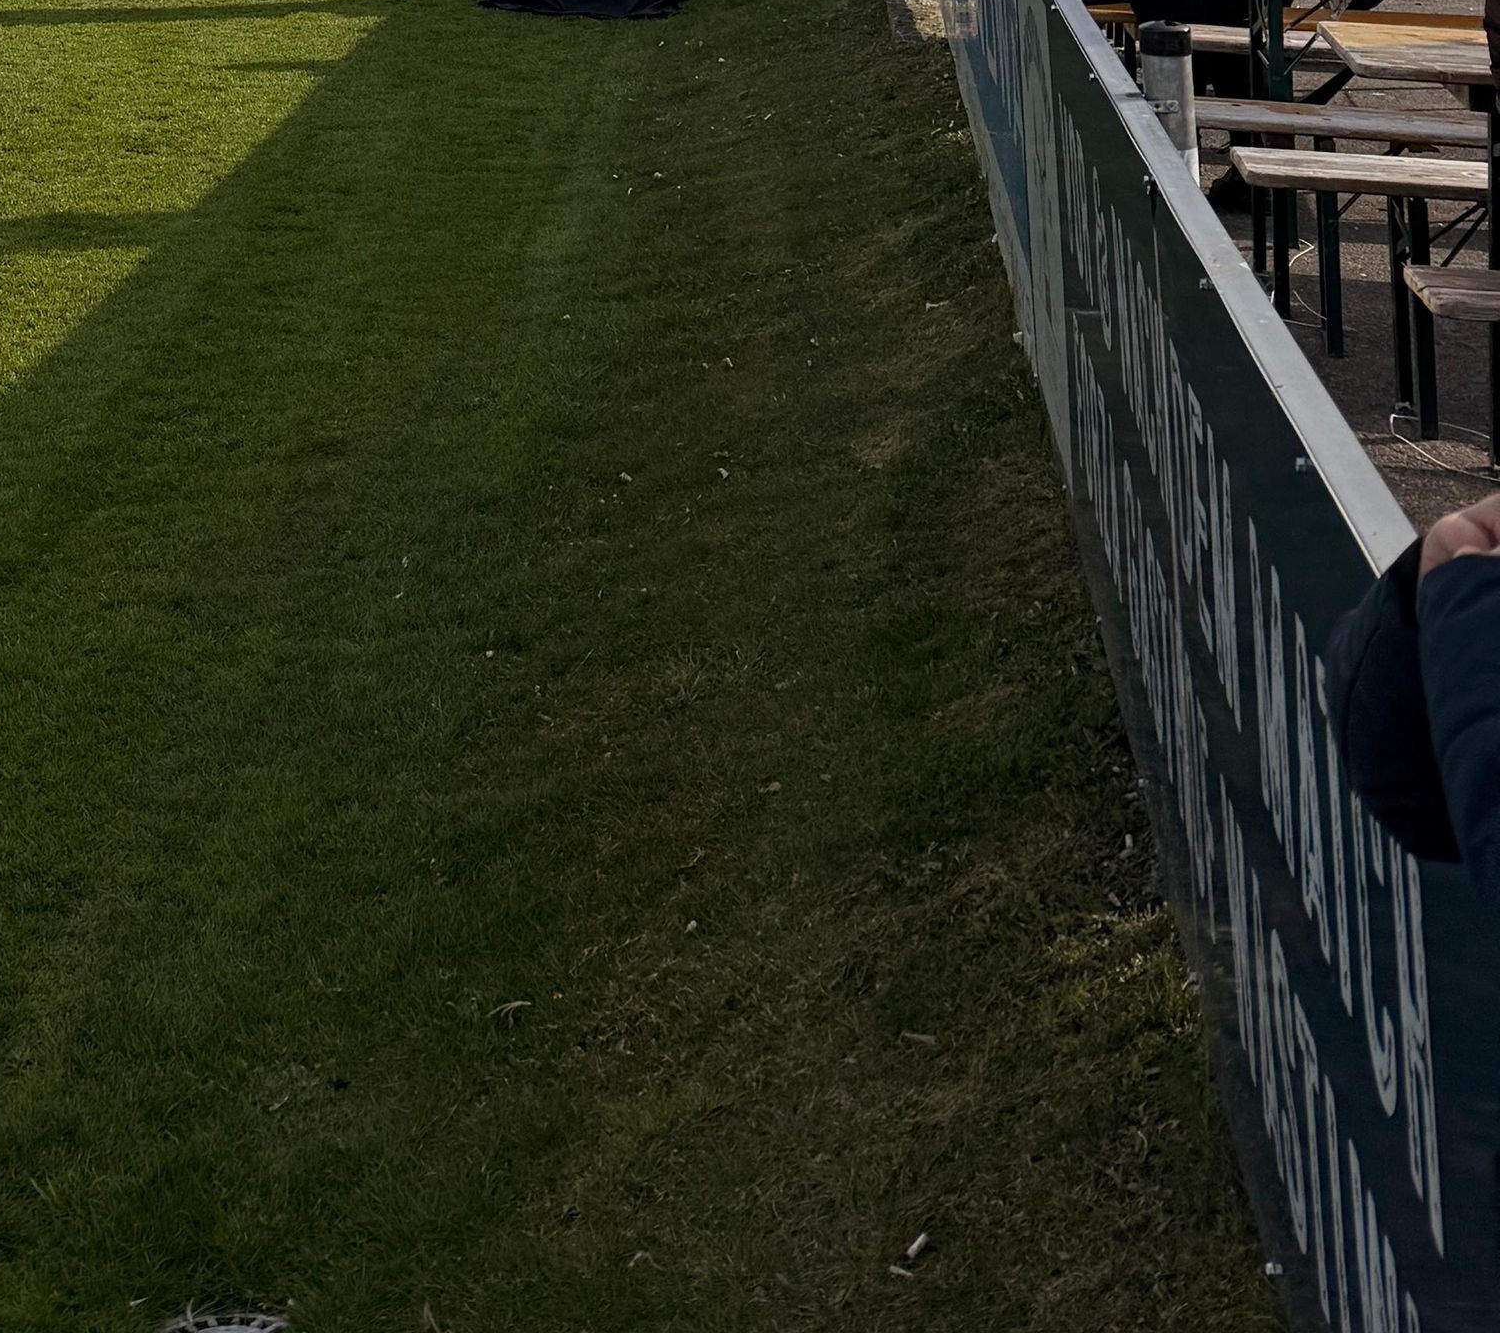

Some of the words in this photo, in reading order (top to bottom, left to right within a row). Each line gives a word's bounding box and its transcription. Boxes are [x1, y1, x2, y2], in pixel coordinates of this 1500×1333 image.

[1058, 91, 1094, 310] VOR
[1092, 165, 1113, 352] &
[1109, 200, 1169, 523] NACH
[1168, 334, 1241, 735] DEM
[1248, 513, 1444, 1261] MATCH
[1073, 310, 1123, 608] FORZA
[1120, 439, 1217, 947] GASTHOF
